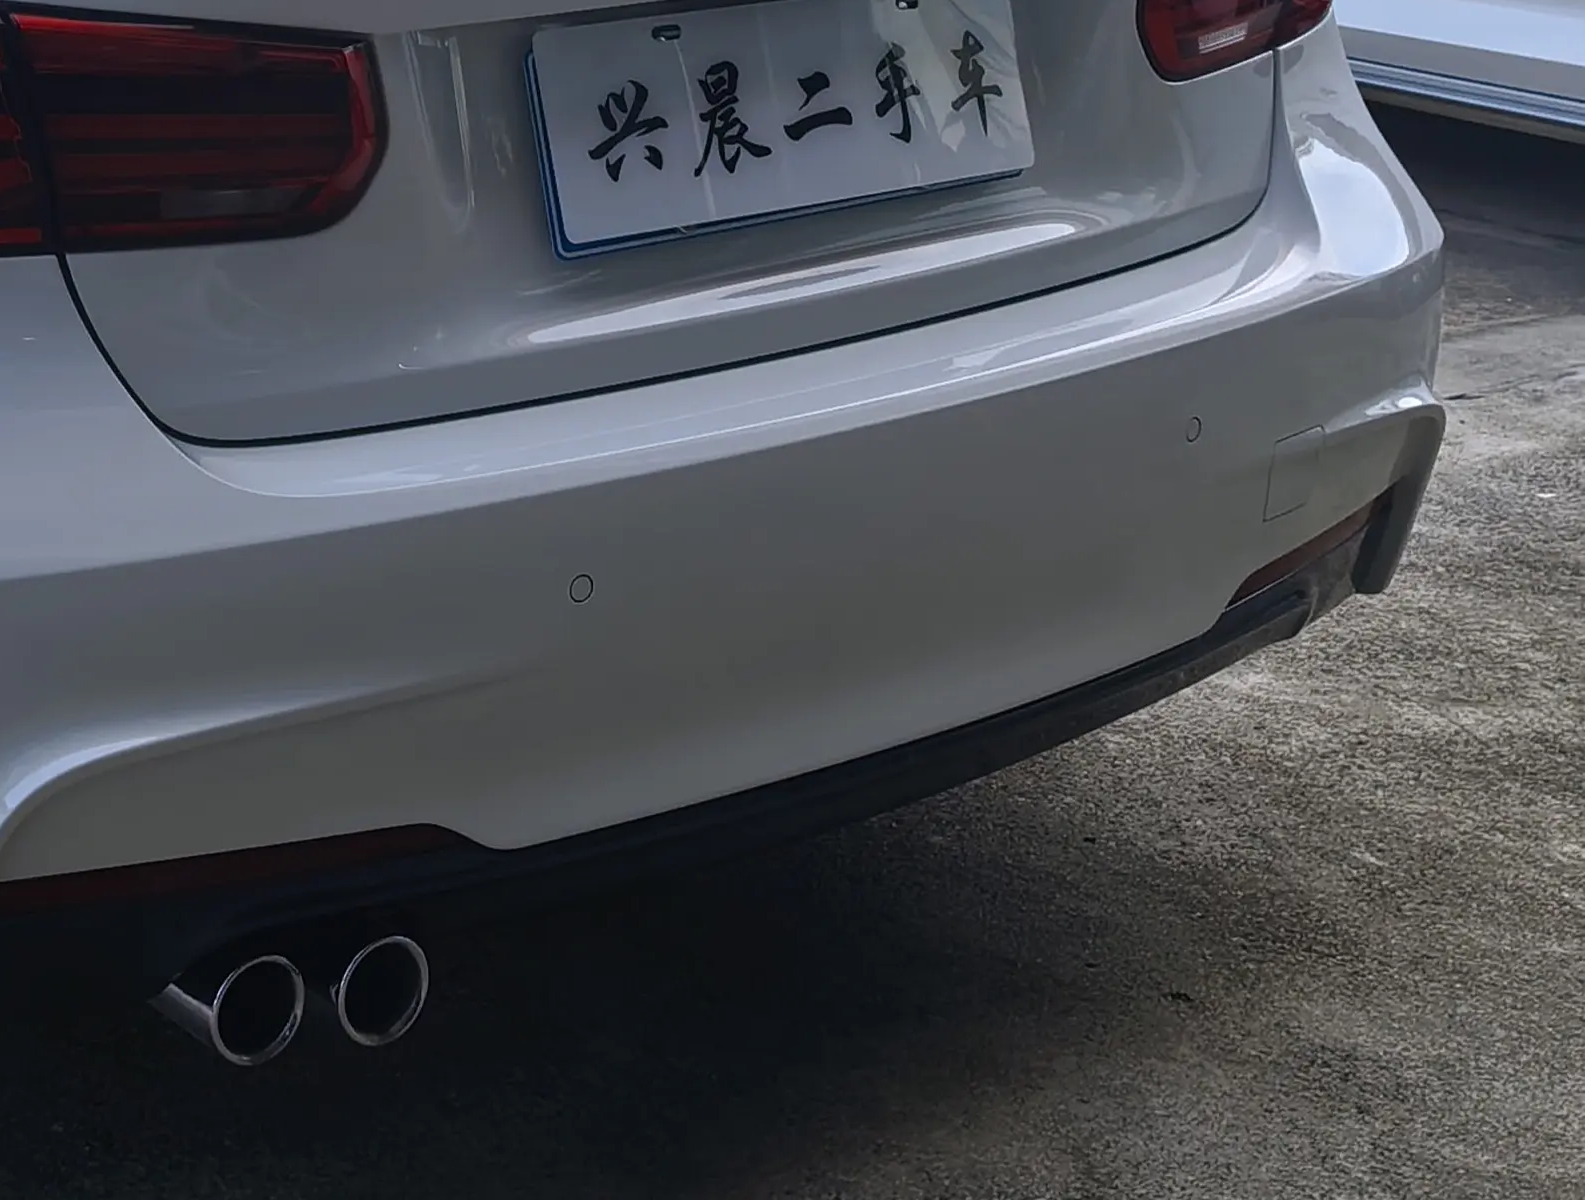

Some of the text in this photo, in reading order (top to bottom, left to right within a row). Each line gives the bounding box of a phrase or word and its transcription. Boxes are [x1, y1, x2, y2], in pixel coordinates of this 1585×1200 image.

[587, 29, 1003, 183] 兴晨二手车
